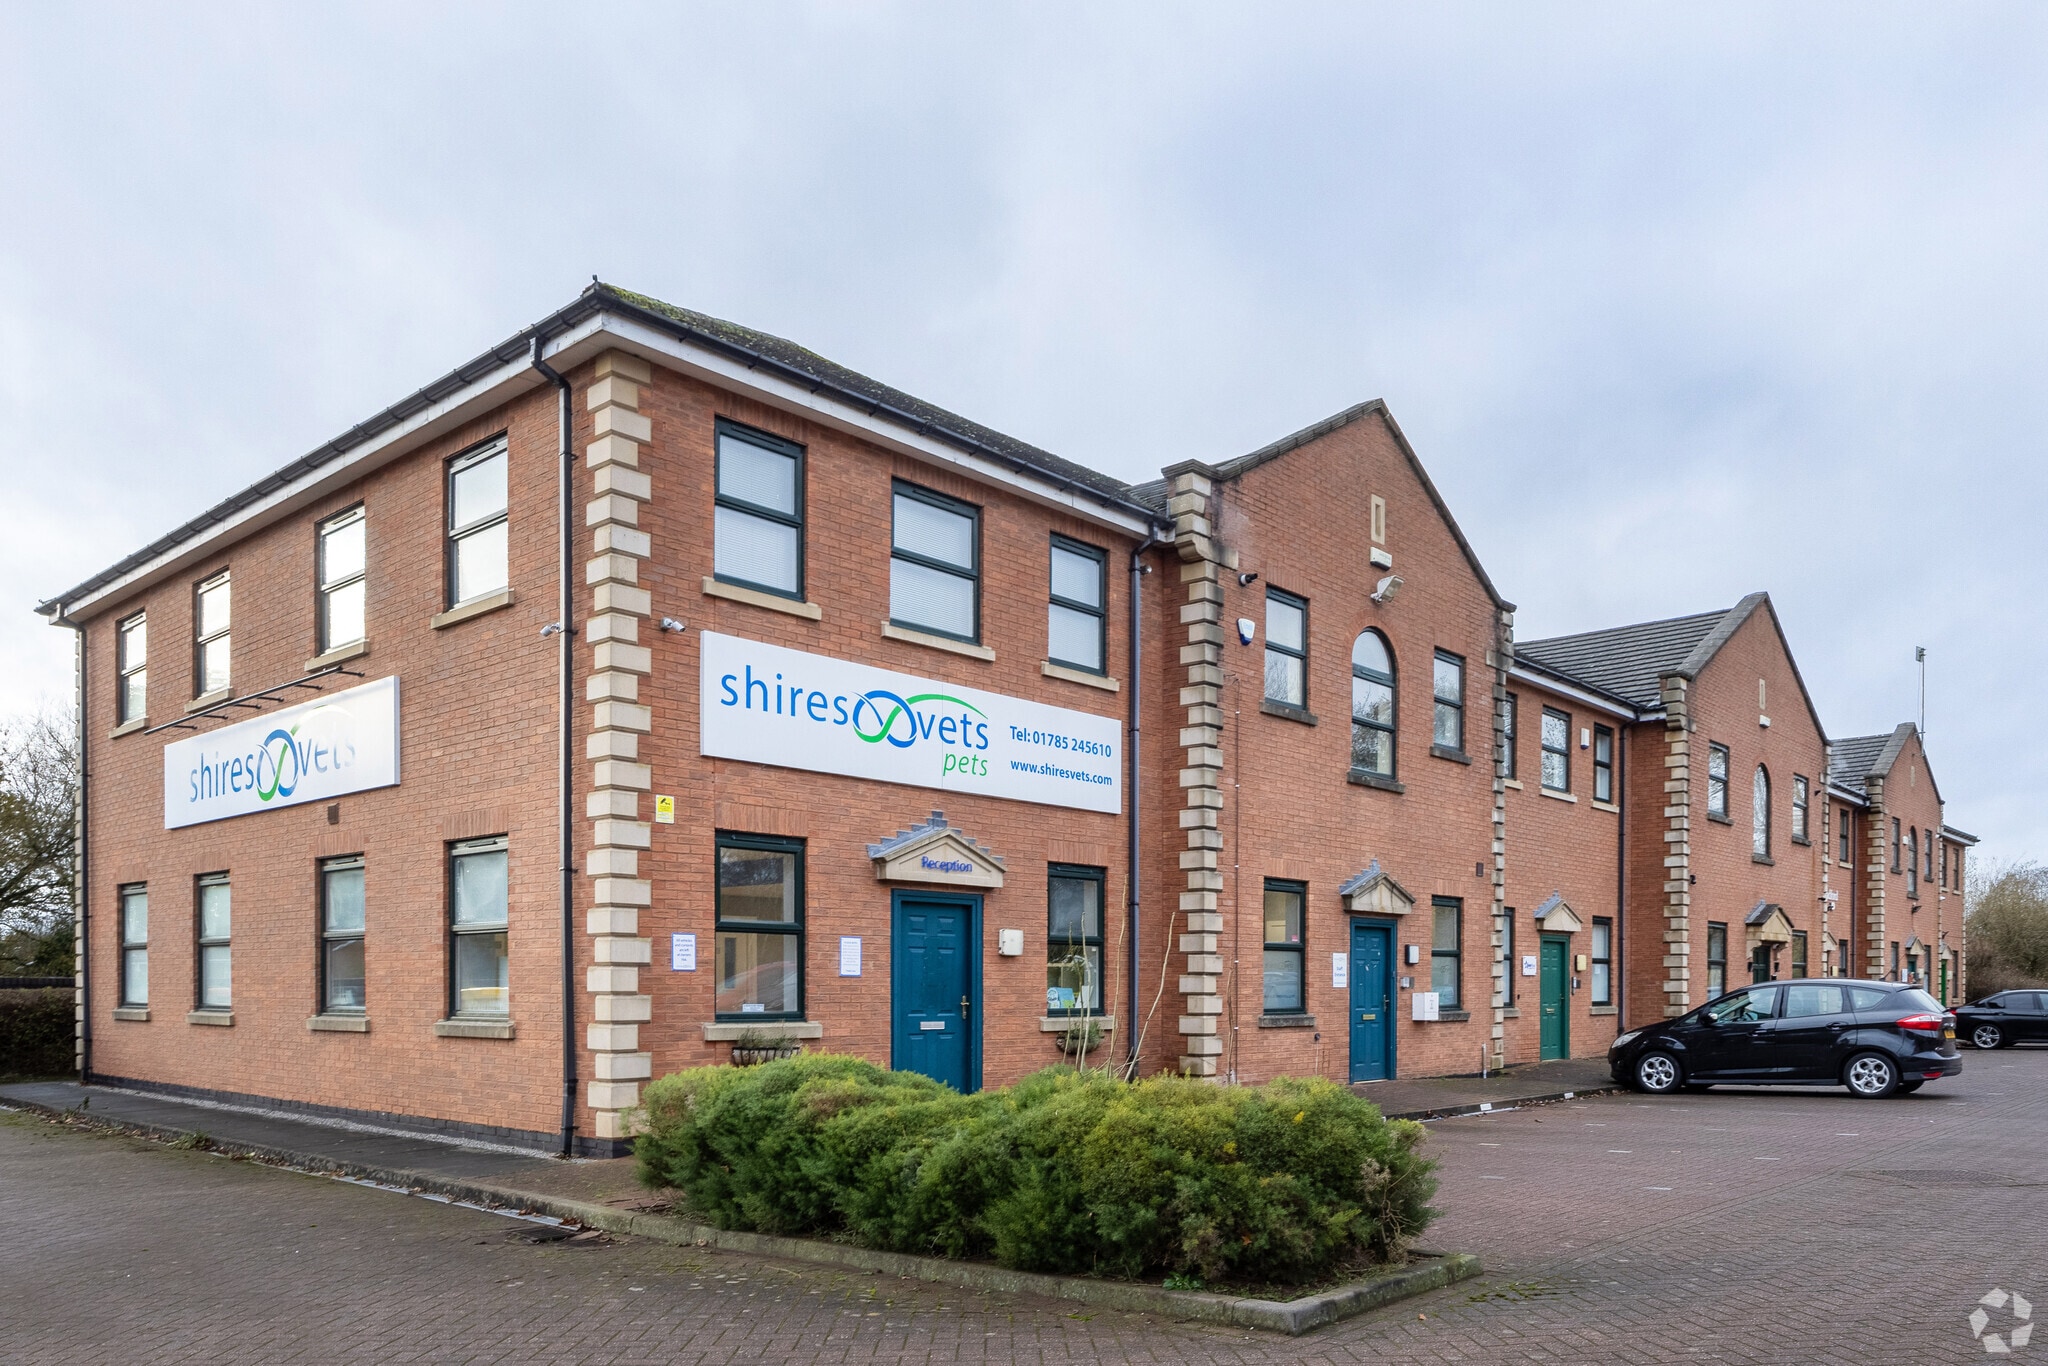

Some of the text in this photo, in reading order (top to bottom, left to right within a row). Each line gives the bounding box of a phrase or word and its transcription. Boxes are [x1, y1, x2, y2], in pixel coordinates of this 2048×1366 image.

[720, 664, 989, 750] shires vets
[1071, 738, 1112, 757] 245610
[189, 750, 254, 802] shires
[942, 753, 988, 777] pets
[1010, 760, 1113, 786] www.shiresvets.com
[921, 856, 973, 873] Reception
